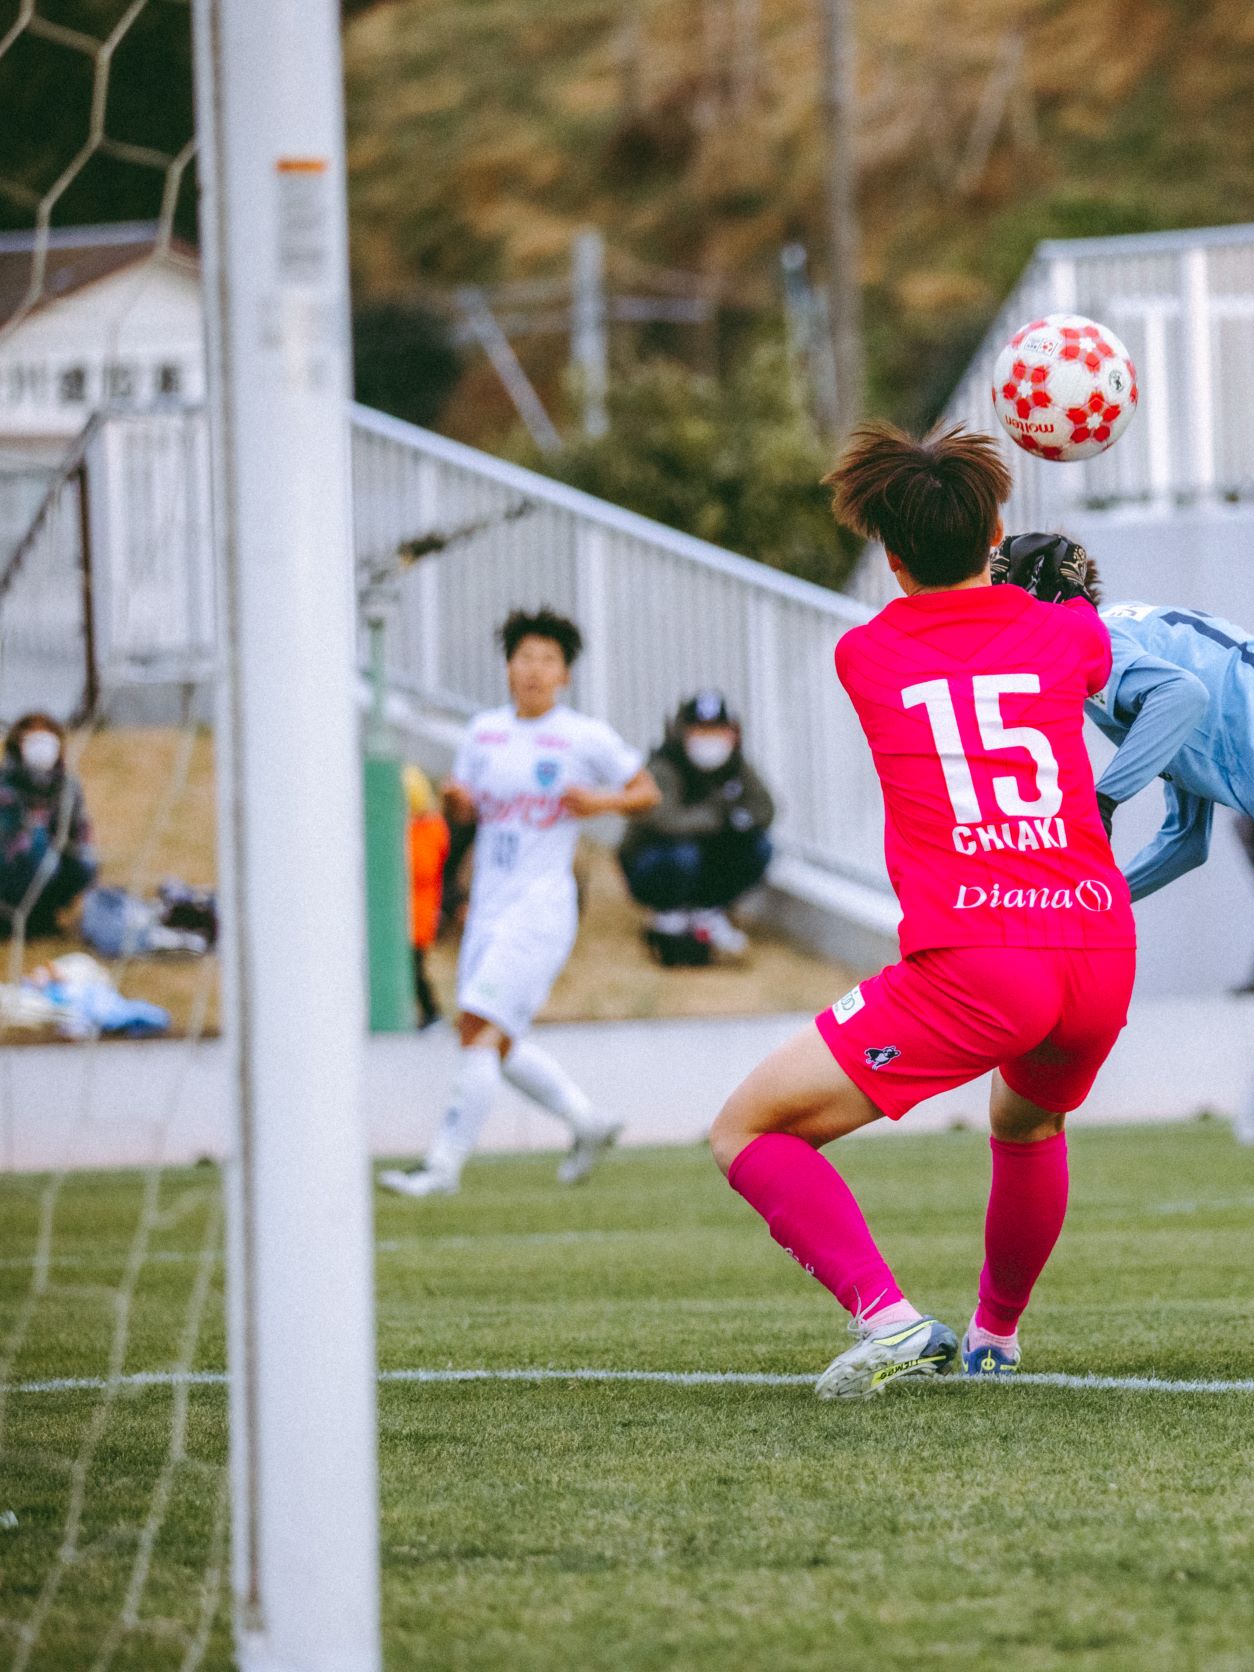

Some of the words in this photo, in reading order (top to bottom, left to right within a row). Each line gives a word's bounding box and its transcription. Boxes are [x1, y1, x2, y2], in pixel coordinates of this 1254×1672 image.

[1005, 415, 1055, 434] molten
[901, 673, 1063, 825] 15
[952, 817, 1068, 856] CHIAKI
[953, 883, 1074, 909] Diana
